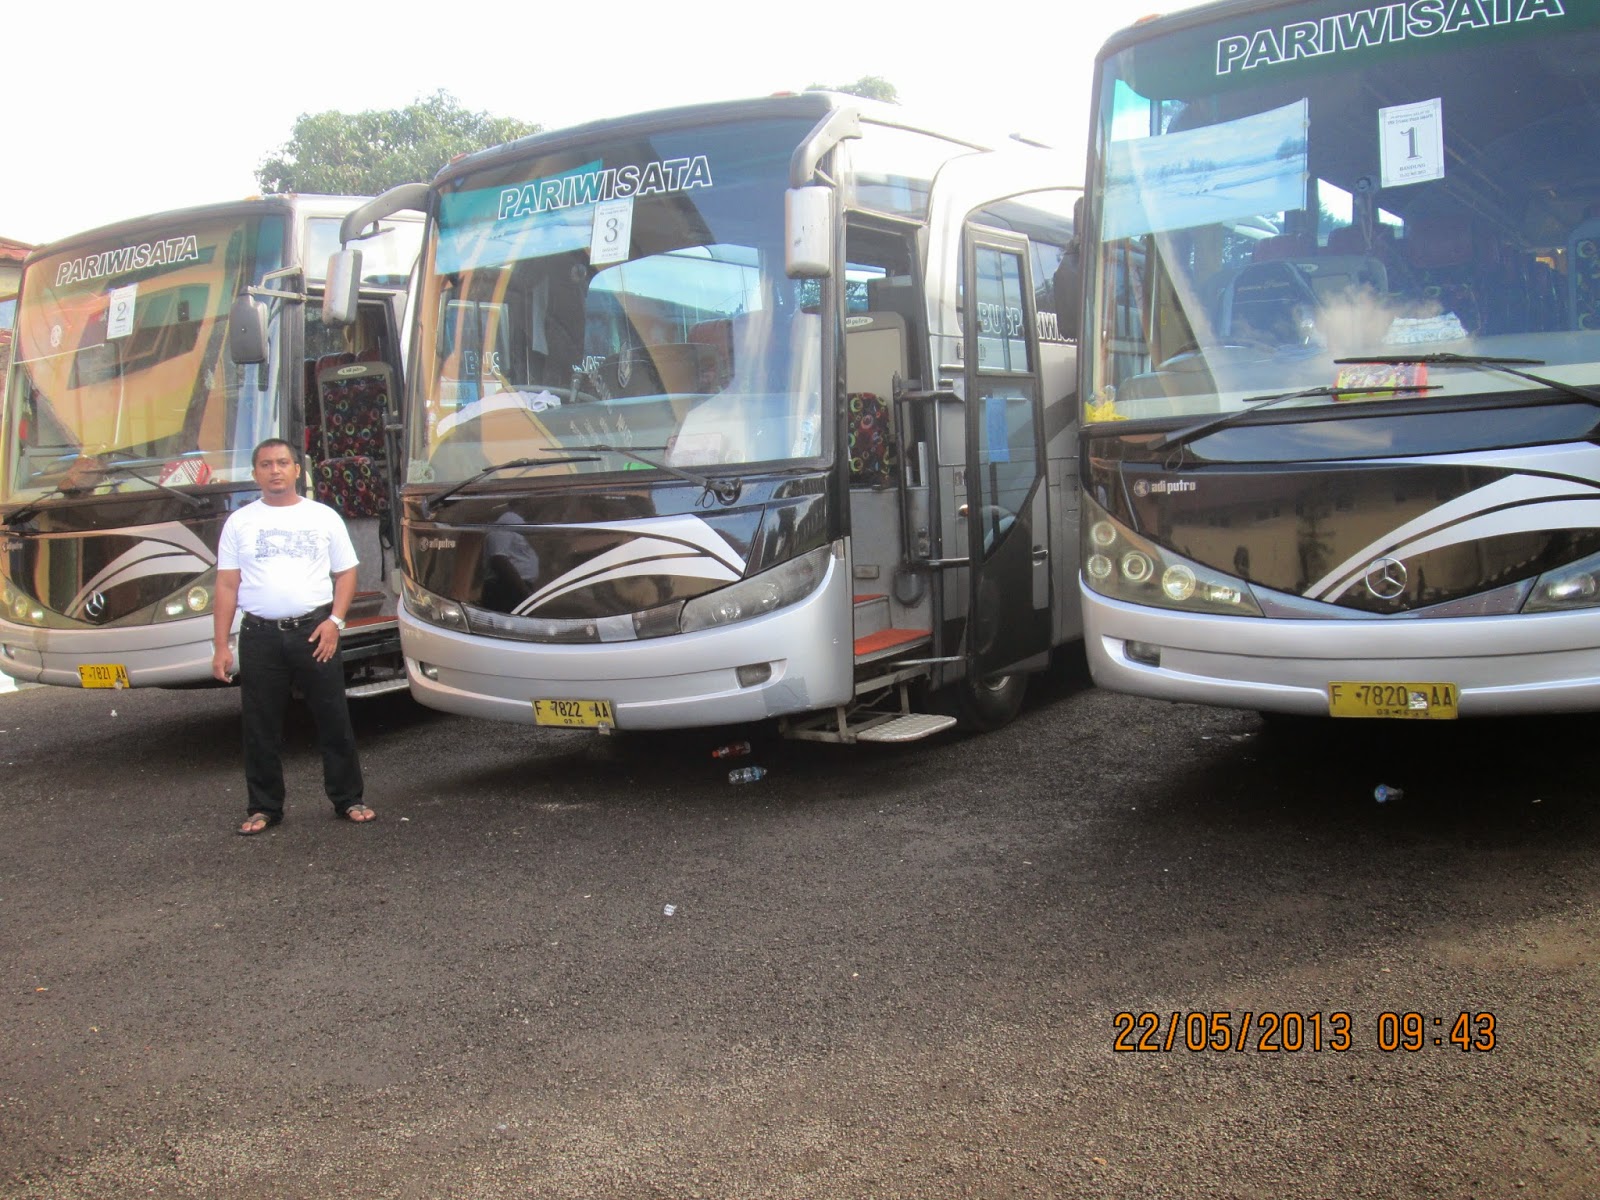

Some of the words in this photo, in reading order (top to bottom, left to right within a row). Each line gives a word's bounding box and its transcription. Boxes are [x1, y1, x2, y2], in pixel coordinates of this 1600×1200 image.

[1216, 0, 1565, 75] PARIWISATA
[1400, 126, 1423, 161] 1
[498, 154, 713, 220] PARIWISATA
[604, 217, 618, 243] 3
[56, 235, 199, 287] PARIWISATA
[115, 302, 127, 322] 2
[79, 666, 85, 680] F
[91, 666, 111, 680] 7821
[116, 666, 127, 680] AA
[534, 700, 542, 716] F
[551, 701, 583, 717] 7822
[594, 702, 609, 718] AA
[1331, 685, 1343, 706] F
[1360, 685, 1409, 707] 7820
[1431, 686, 1453, 707] AA
